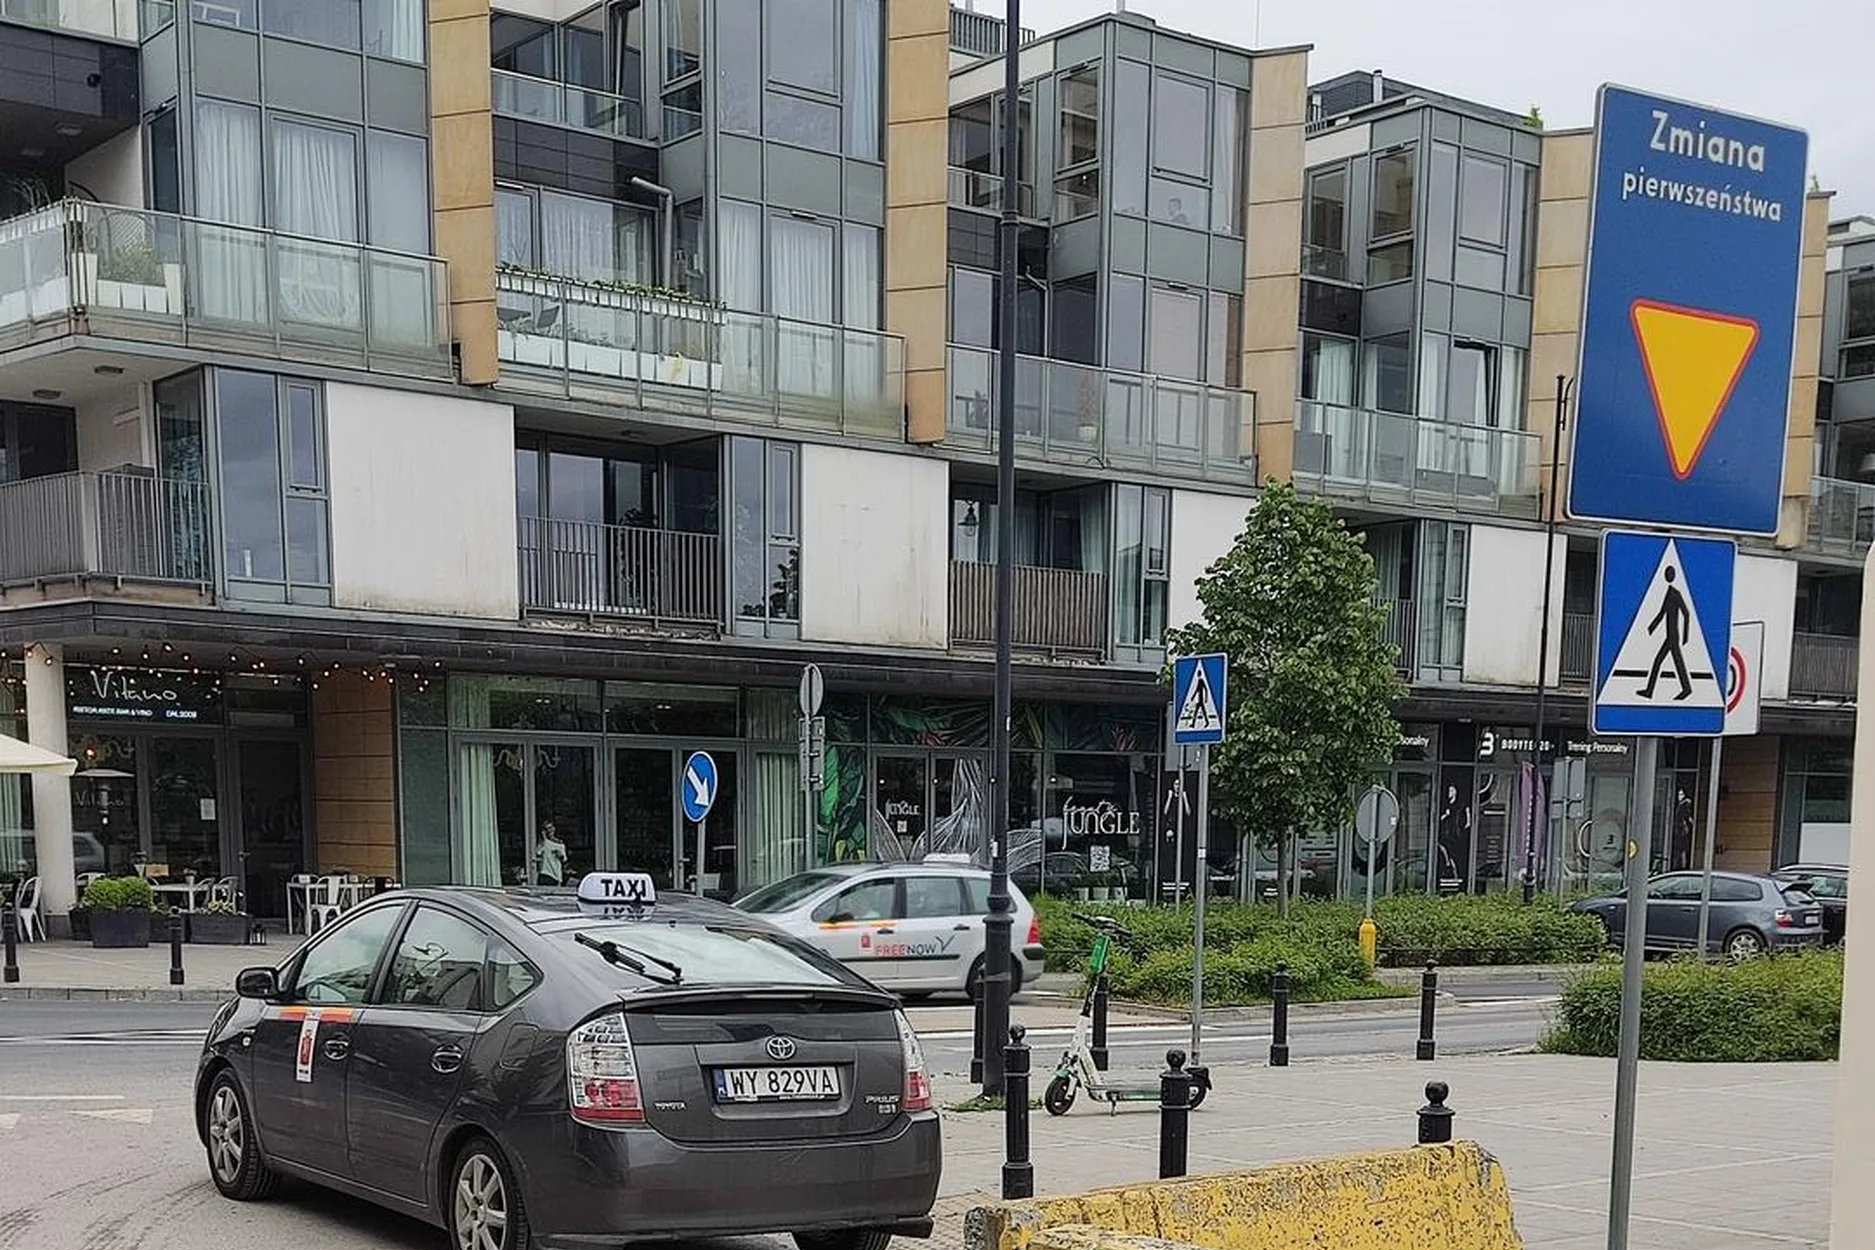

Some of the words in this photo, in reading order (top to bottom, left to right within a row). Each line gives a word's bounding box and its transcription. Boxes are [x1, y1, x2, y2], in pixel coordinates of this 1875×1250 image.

[1650, 110, 1765, 172] Zmiana
[1622, 166, 1782, 222] pierwszeństwa
[90, 670, 177, 700] Vitano
[1062, 810, 1140, 850] JUNGLE
[601, 879, 647, 898] TAXI
[730, 1070, 757, 1095] WY
[767, 1069, 834, 1093] 829VA
